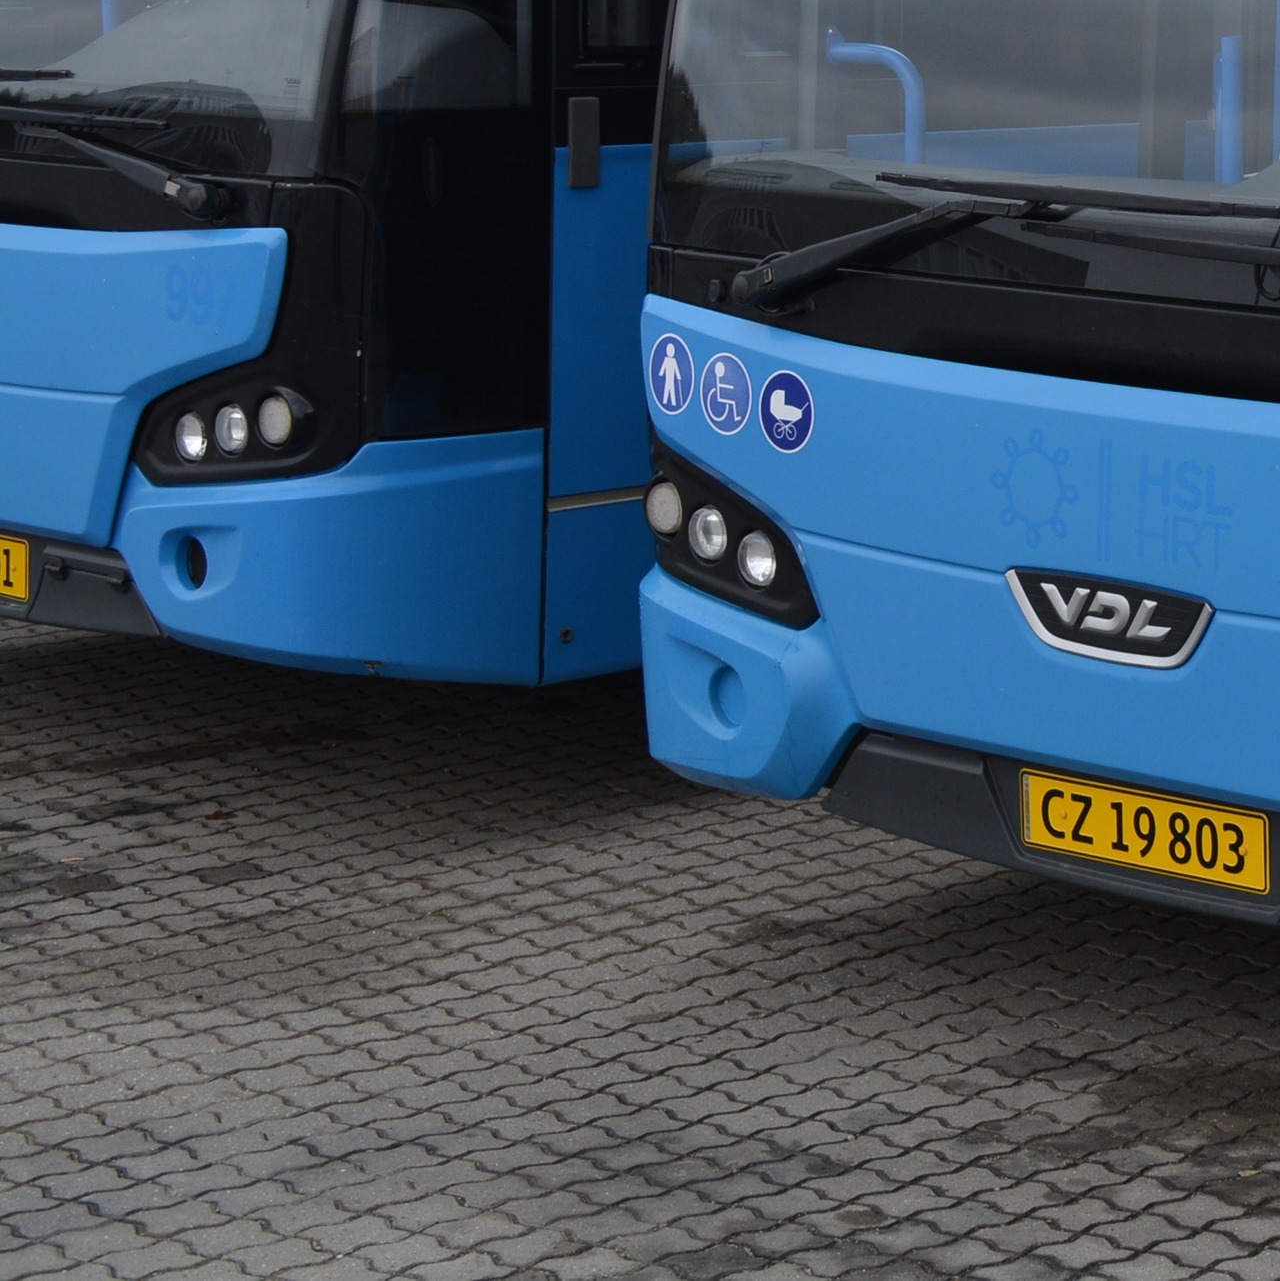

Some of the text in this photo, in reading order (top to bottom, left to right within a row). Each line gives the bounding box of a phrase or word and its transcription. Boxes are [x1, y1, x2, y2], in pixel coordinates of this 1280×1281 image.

[166, 263, 234, 328] 997
[1140, 454, 1234, 517] HSL
[0, 548, 13, 588] 1
[1136, 509, 1233, 570] HRT
[1040, 581, 1172, 644] VDL
[1041, 788, 1094, 846] CZ
[1110, 801, 1157, 858] 19
[1168, 811, 1246, 875] 803
